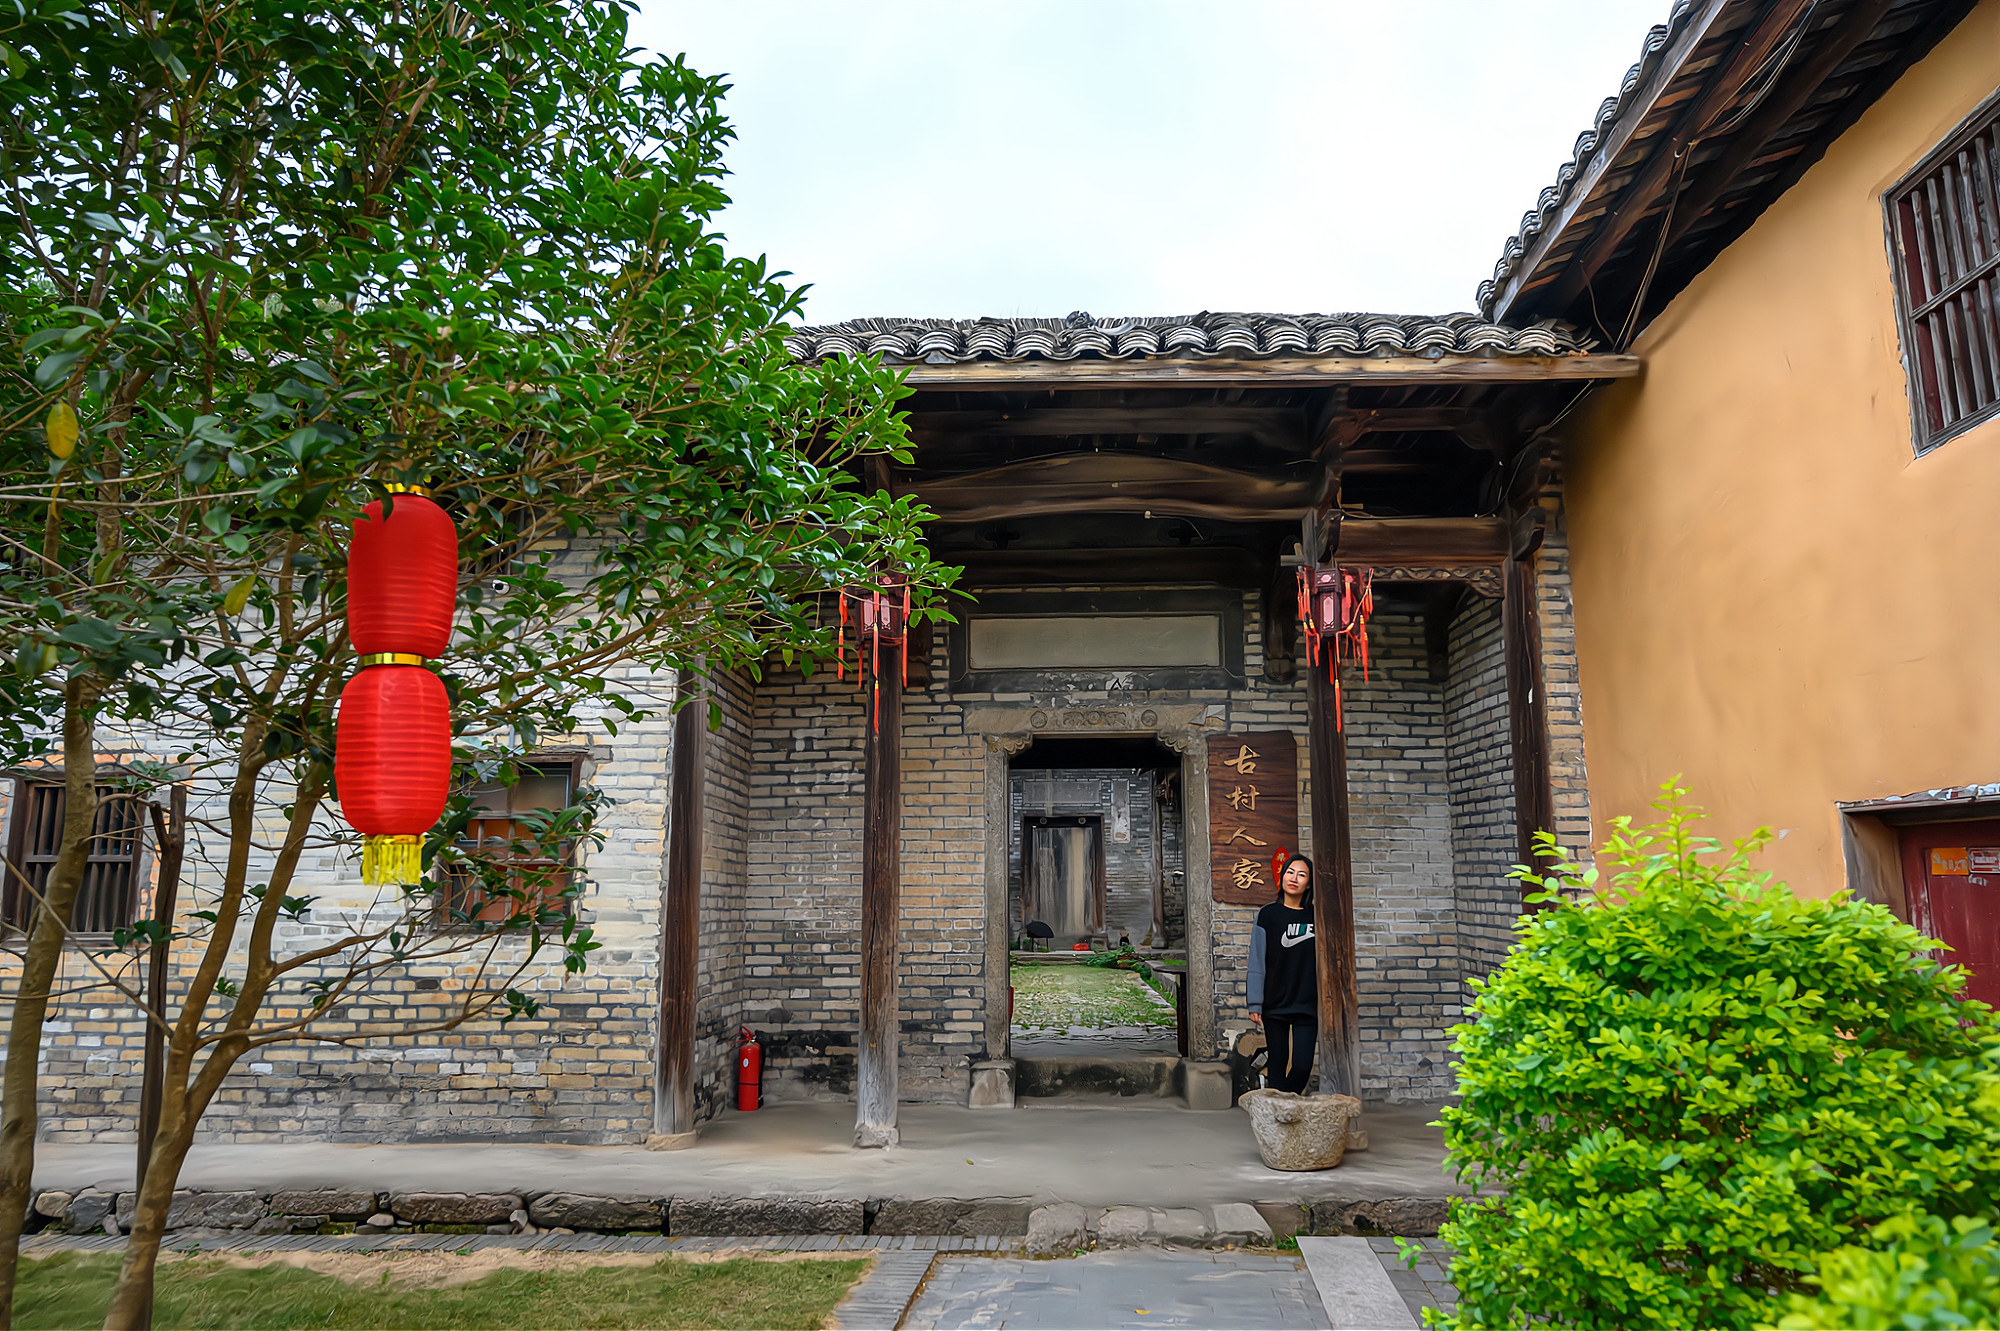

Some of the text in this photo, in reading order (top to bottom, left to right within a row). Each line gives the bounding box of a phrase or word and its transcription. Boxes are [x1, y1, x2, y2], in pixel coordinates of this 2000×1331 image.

[1223, 744, 1268, 890] 古村人家
[1287, 923, 1314, 936] NIKE
